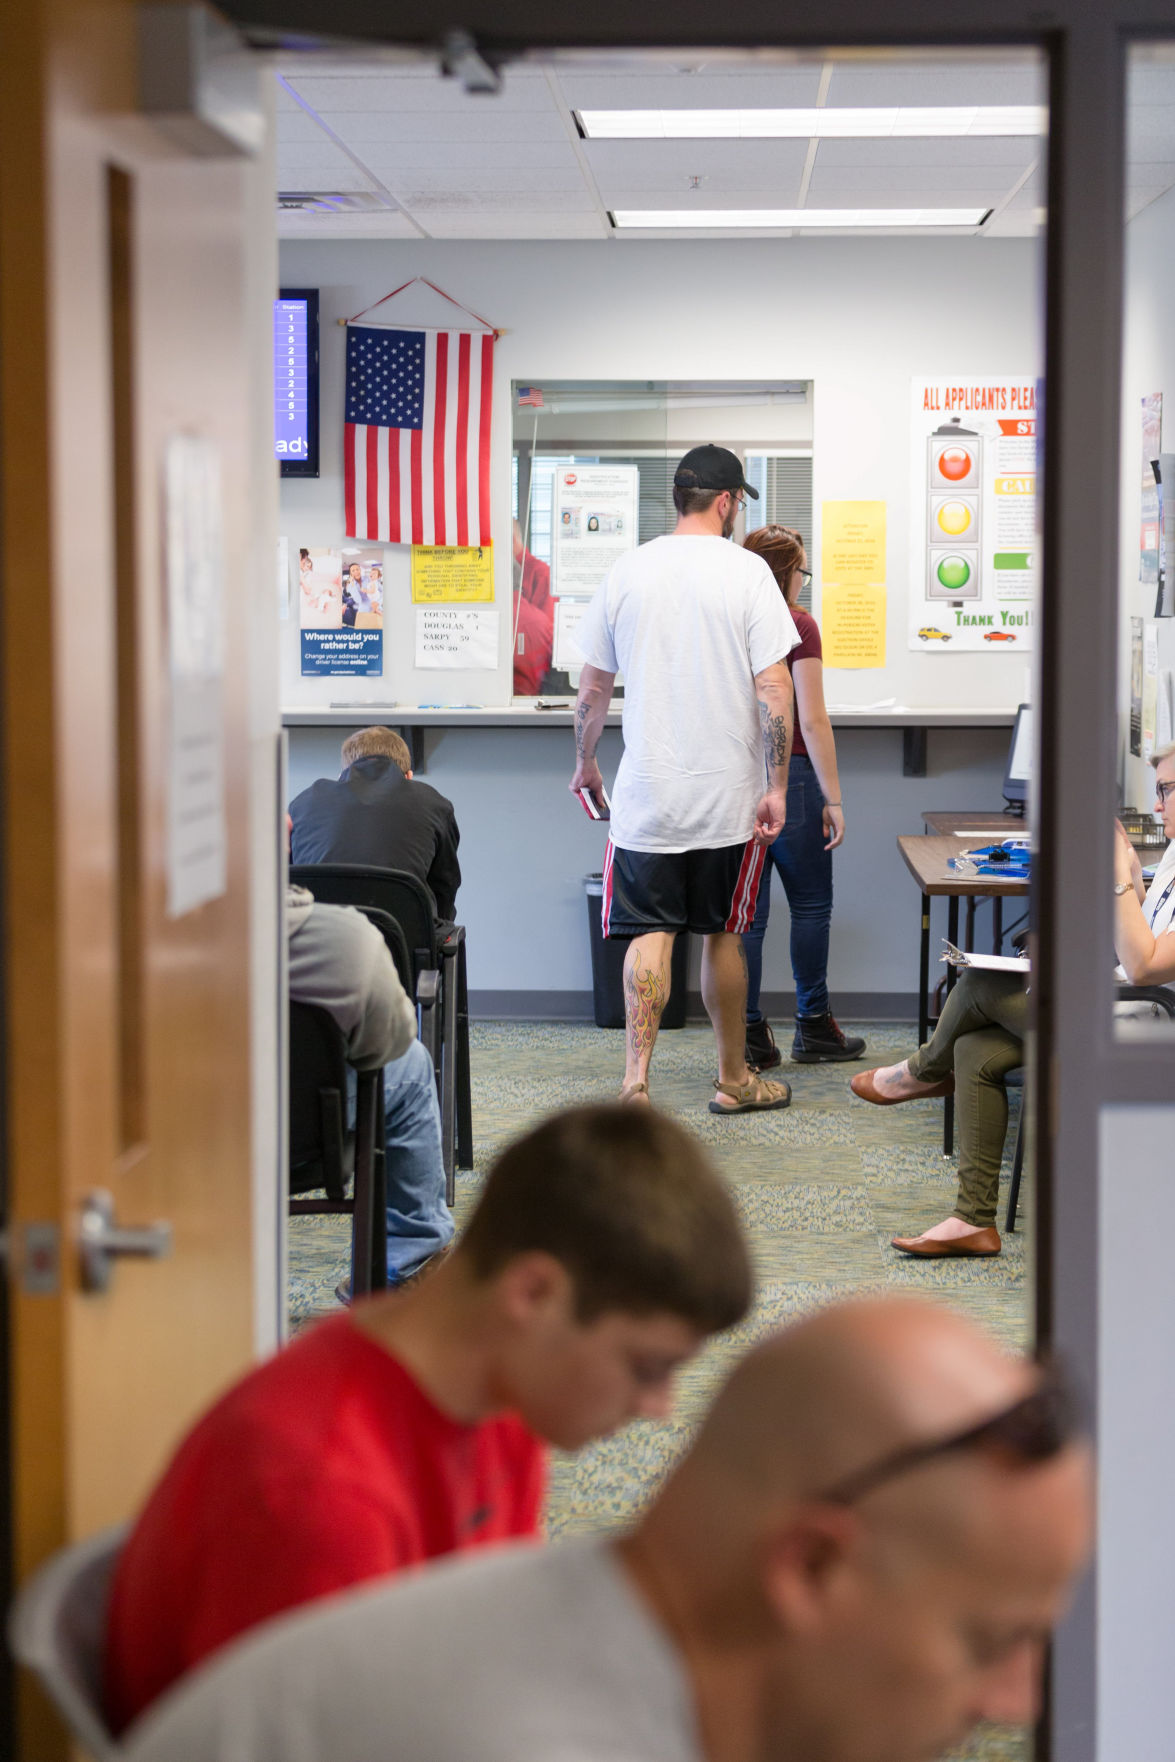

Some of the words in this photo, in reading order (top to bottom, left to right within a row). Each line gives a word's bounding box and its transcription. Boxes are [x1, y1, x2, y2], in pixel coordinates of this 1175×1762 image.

[923, 387, 940, 410] ALL
[945, 387, 1007, 410] APPLICANTS
[424, 622, 464, 630] DOUGLAS
[304, 632, 333, 640] Where
[335, 632, 362, 640] would
[363, 634, 379, 642] you
[320, 641, 347, 649] rather
[348, 641, 364, 649] be?
